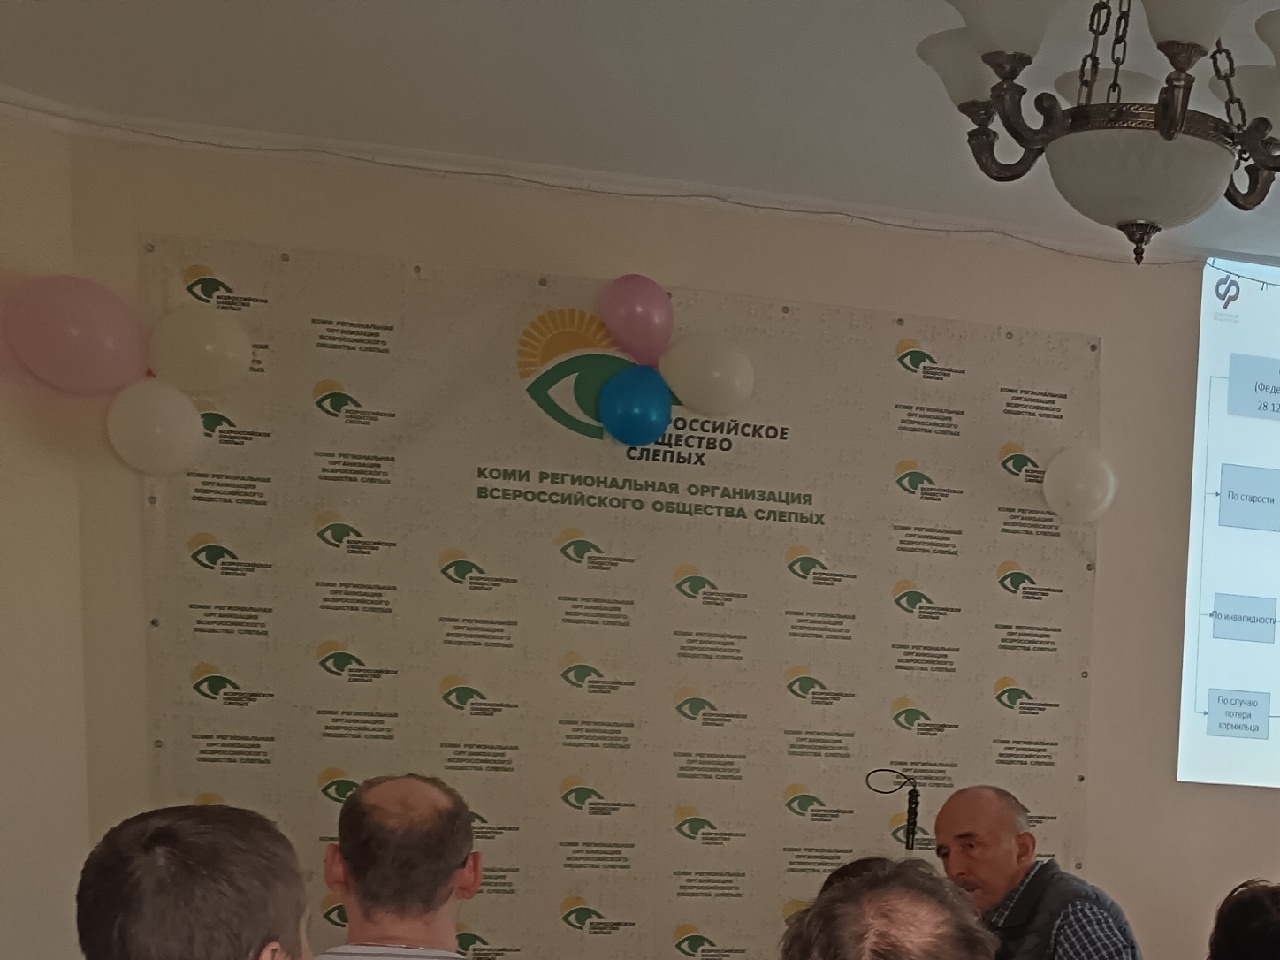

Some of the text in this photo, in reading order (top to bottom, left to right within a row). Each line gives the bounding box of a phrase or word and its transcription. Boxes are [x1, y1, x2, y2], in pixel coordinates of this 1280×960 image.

[668, 416, 789, 440] ОССИЙСКОЕ
[654, 433, 733, 451] ЩЕСТВО
[626, 447, 706, 466] СЛЕПЫХ
[477, 467, 813, 506] КОМИ РЕГИОНАЛЬНАЯ ОРГАНИЗАЦИЯ
[477, 486, 825, 526] ВСЕРОССИЙСКОГО ОБЩЕСТВА СЛЕПЫХ
[1228, 490, 1275, 505] По старости
[1217, 695, 1229, 706] По
